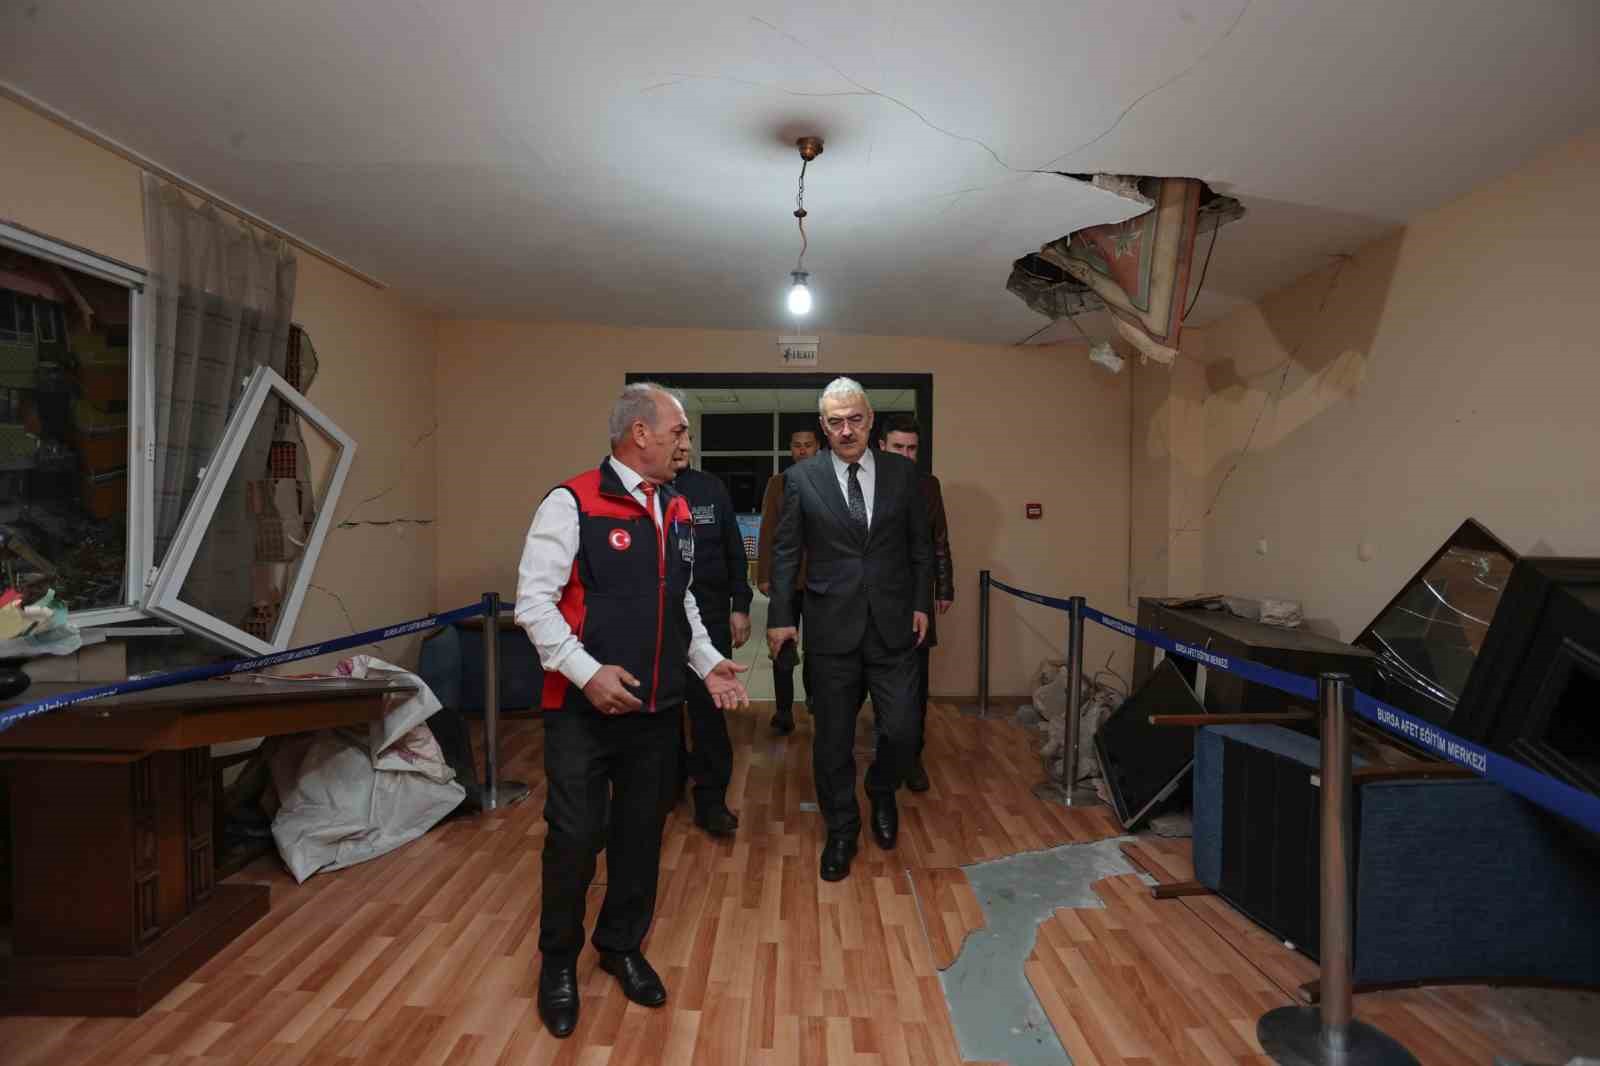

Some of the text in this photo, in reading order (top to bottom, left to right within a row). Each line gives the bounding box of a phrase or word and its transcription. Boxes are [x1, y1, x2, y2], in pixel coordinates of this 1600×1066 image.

[1377, 707, 1487, 773] BURSA AFET EĞİTİM MERKEZİ
